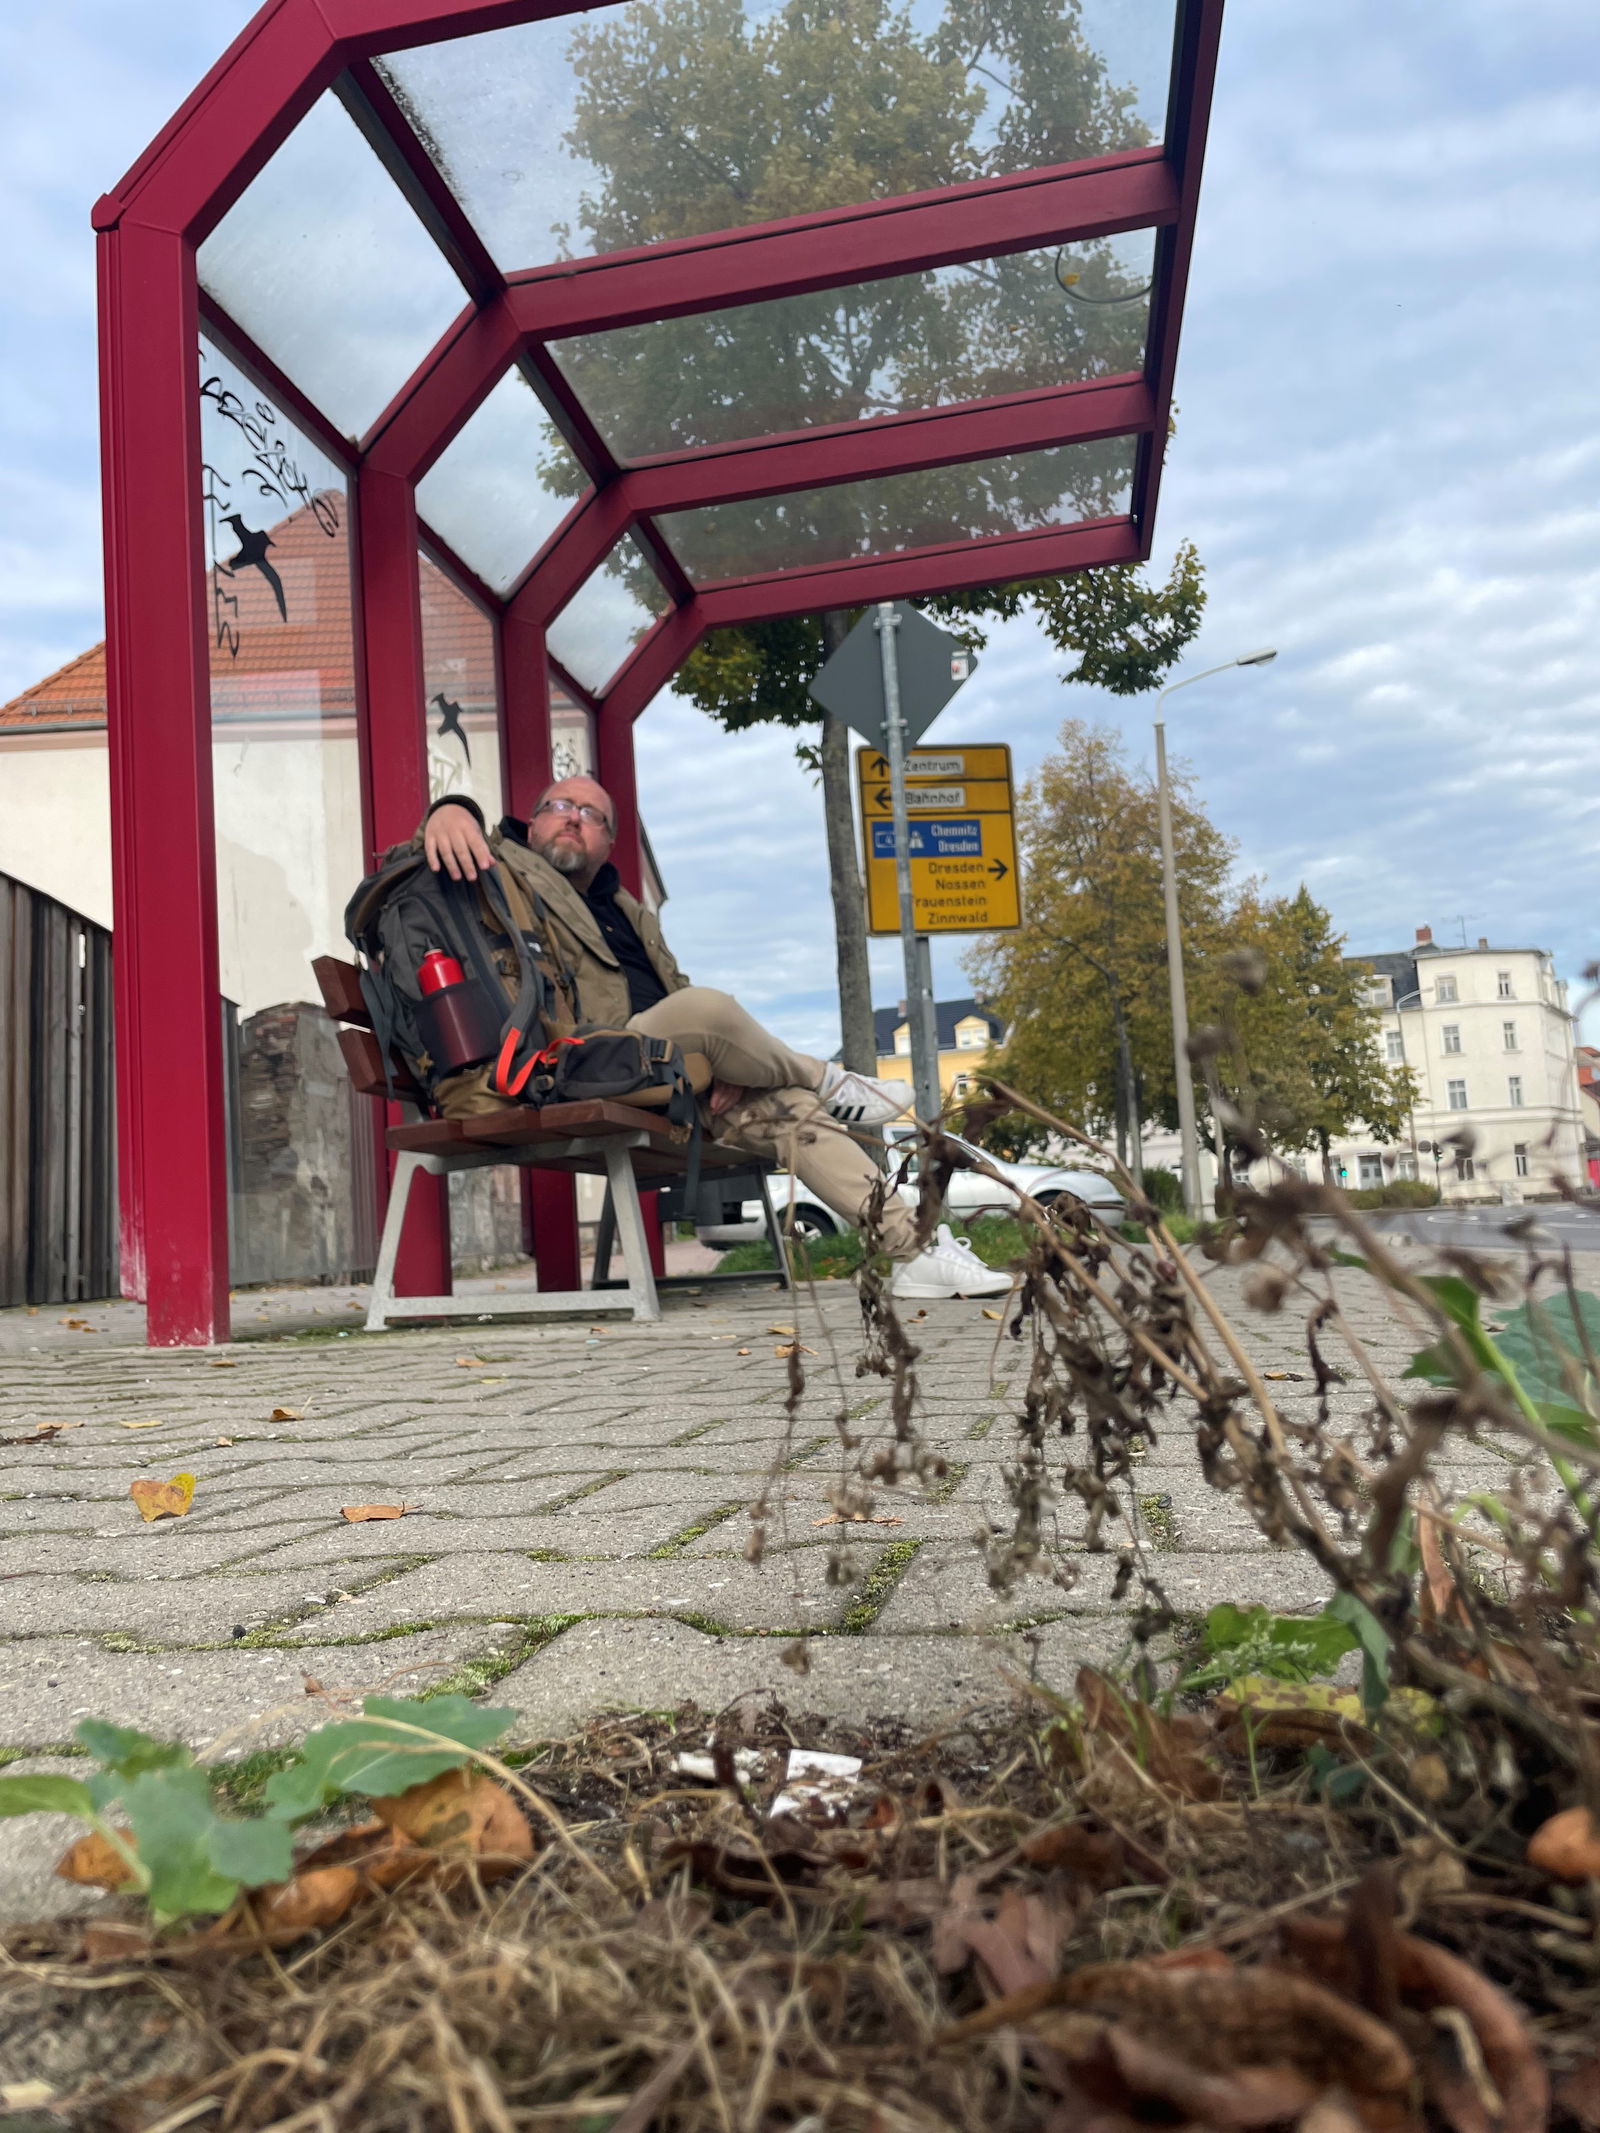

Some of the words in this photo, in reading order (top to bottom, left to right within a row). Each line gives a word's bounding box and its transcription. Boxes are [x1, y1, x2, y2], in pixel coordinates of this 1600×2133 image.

[903, 759, 960, 772] Zentrum
[905, 791, 960, 805] Bahnhof
[930, 824, 978, 838] Chemnitz
[937, 839, 979, 853] Dresden
[928, 862, 985, 875] Dresden
[935, 879, 986, 891] Nossen
[911, 894, 987, 908] rauenstein
[928, 911, 989, 925] Zinnwald
